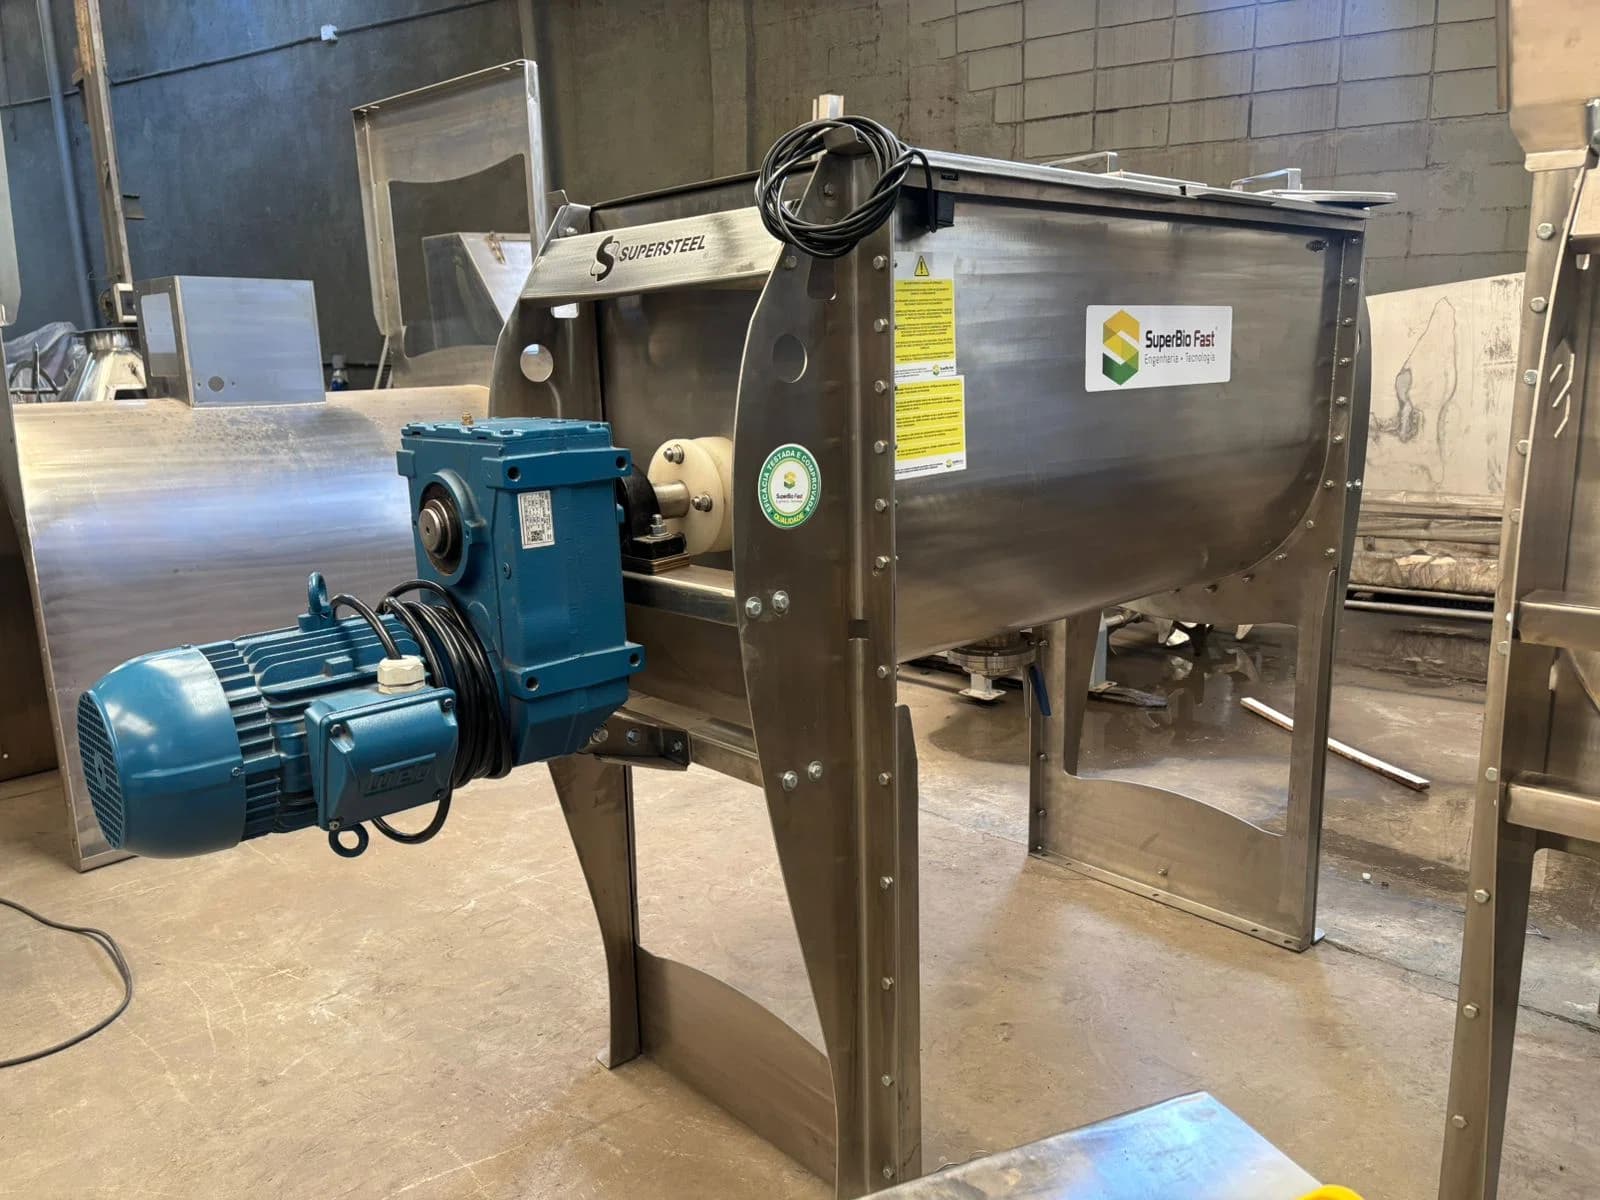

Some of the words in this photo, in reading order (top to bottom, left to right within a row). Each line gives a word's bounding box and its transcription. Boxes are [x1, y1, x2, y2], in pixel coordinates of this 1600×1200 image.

[619, 235, 705, 262] SUPERSTEEL
[1145, 330, 1192, 352] SuperBio
[1193, 329, 1216, 348] Fast
[767, 450, 795, 470] TESTADA
[797, 451, 802, 459] E
[801, 455, 817, 512] COMPROVADA
[773, 512, 805, 525] QUALIDADE
